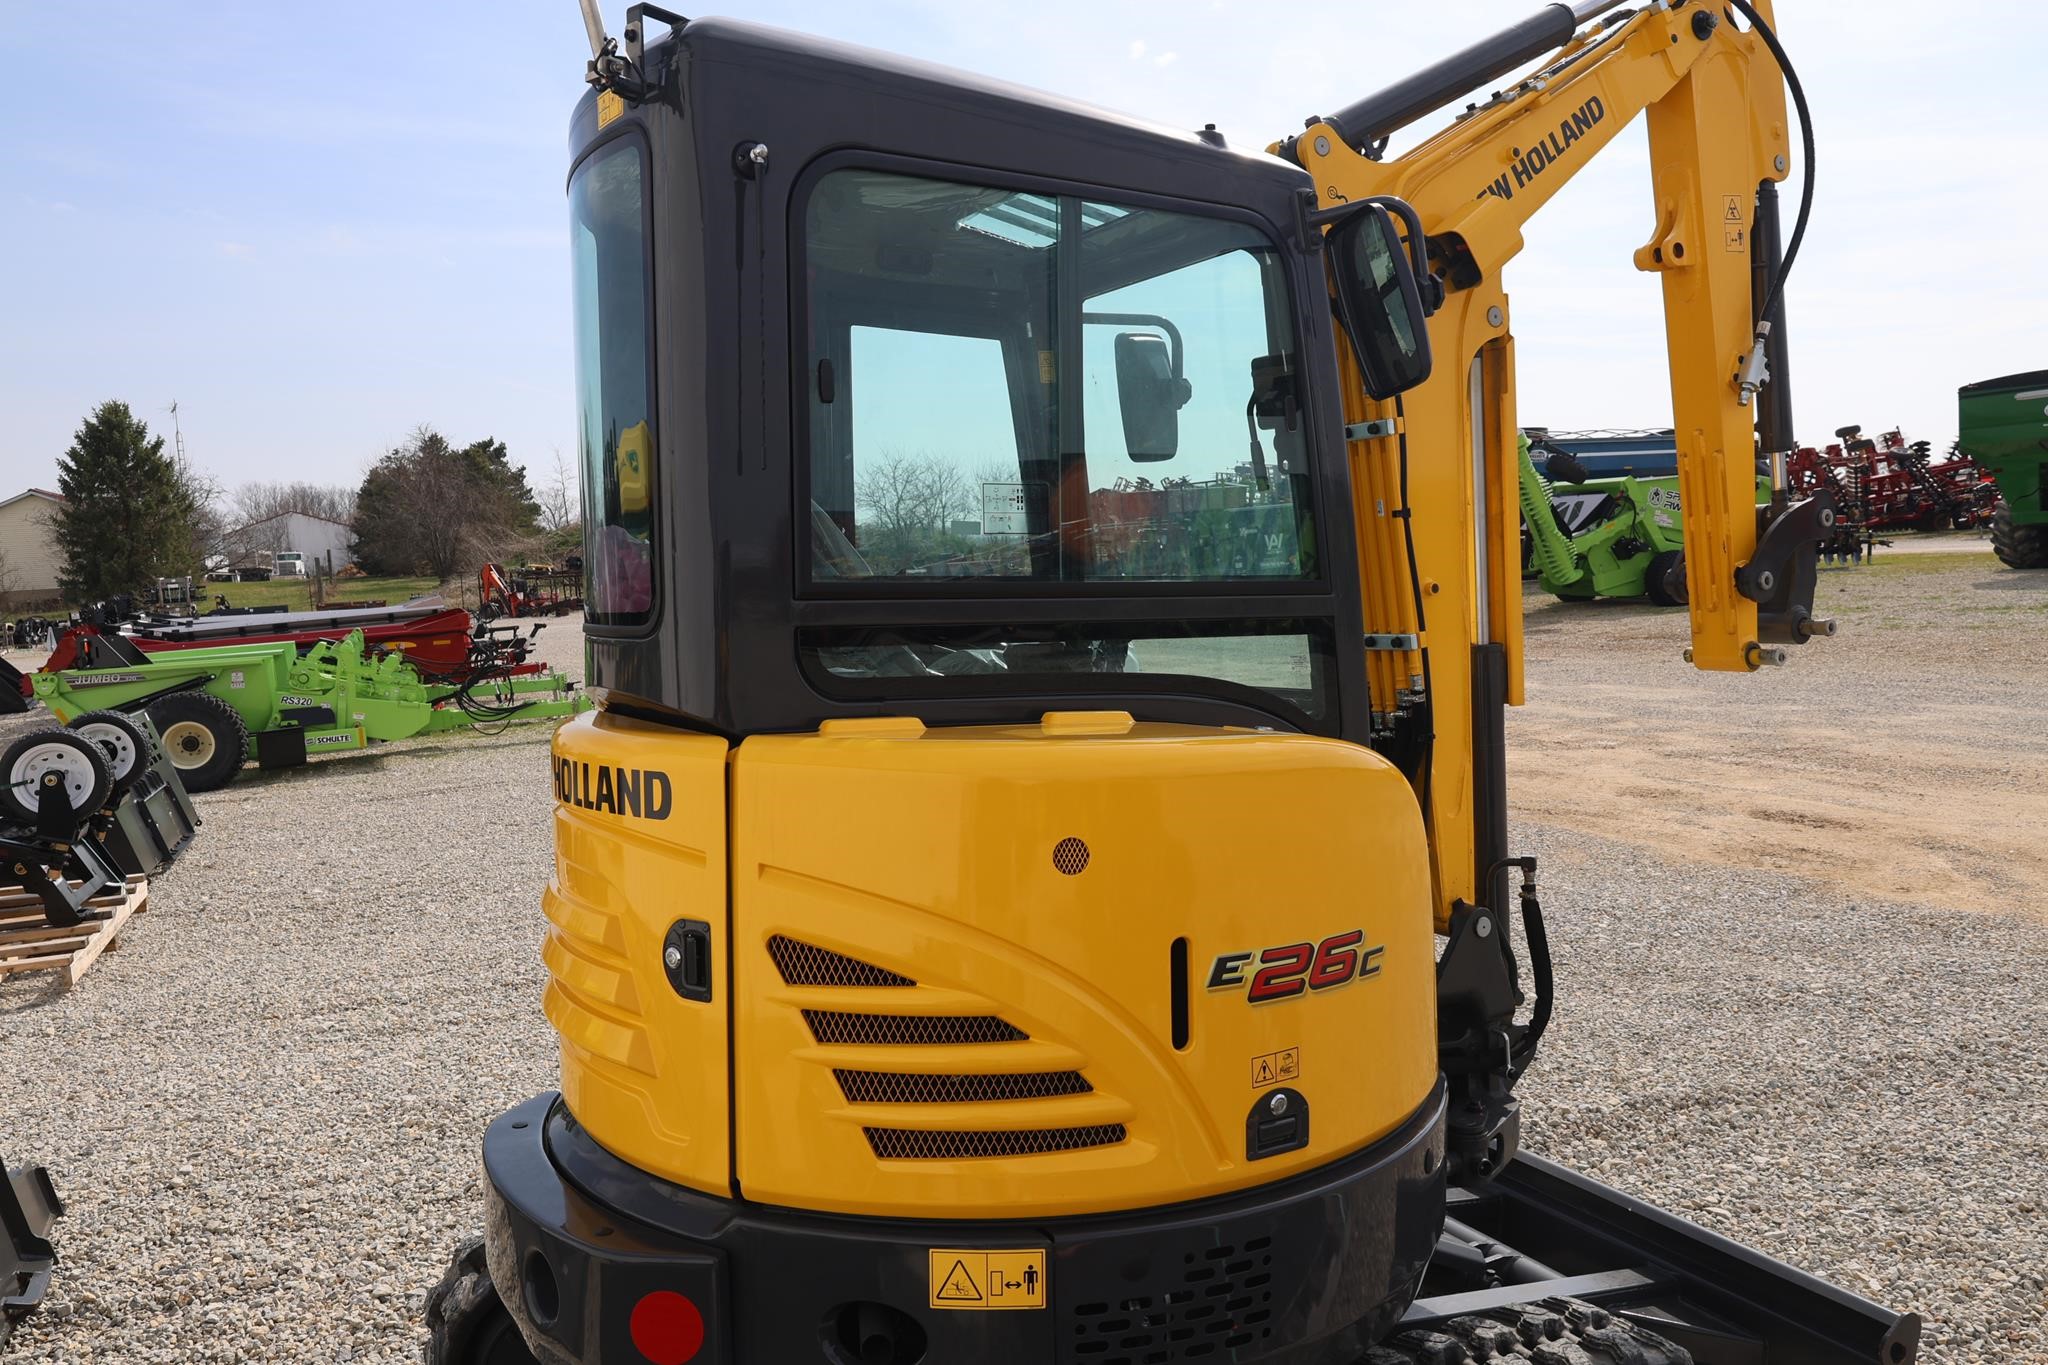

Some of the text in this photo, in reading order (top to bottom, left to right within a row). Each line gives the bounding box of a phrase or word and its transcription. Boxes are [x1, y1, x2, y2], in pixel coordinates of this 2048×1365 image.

[1511, 95, 1605, 189] HOLLAND
[74, 673, 121, 685] JUMBO
[280, 695, 313, 706] RS320
[317, 734, 351, 744] SCHULTE
[552, 754, 673, 821] HOLLAND
